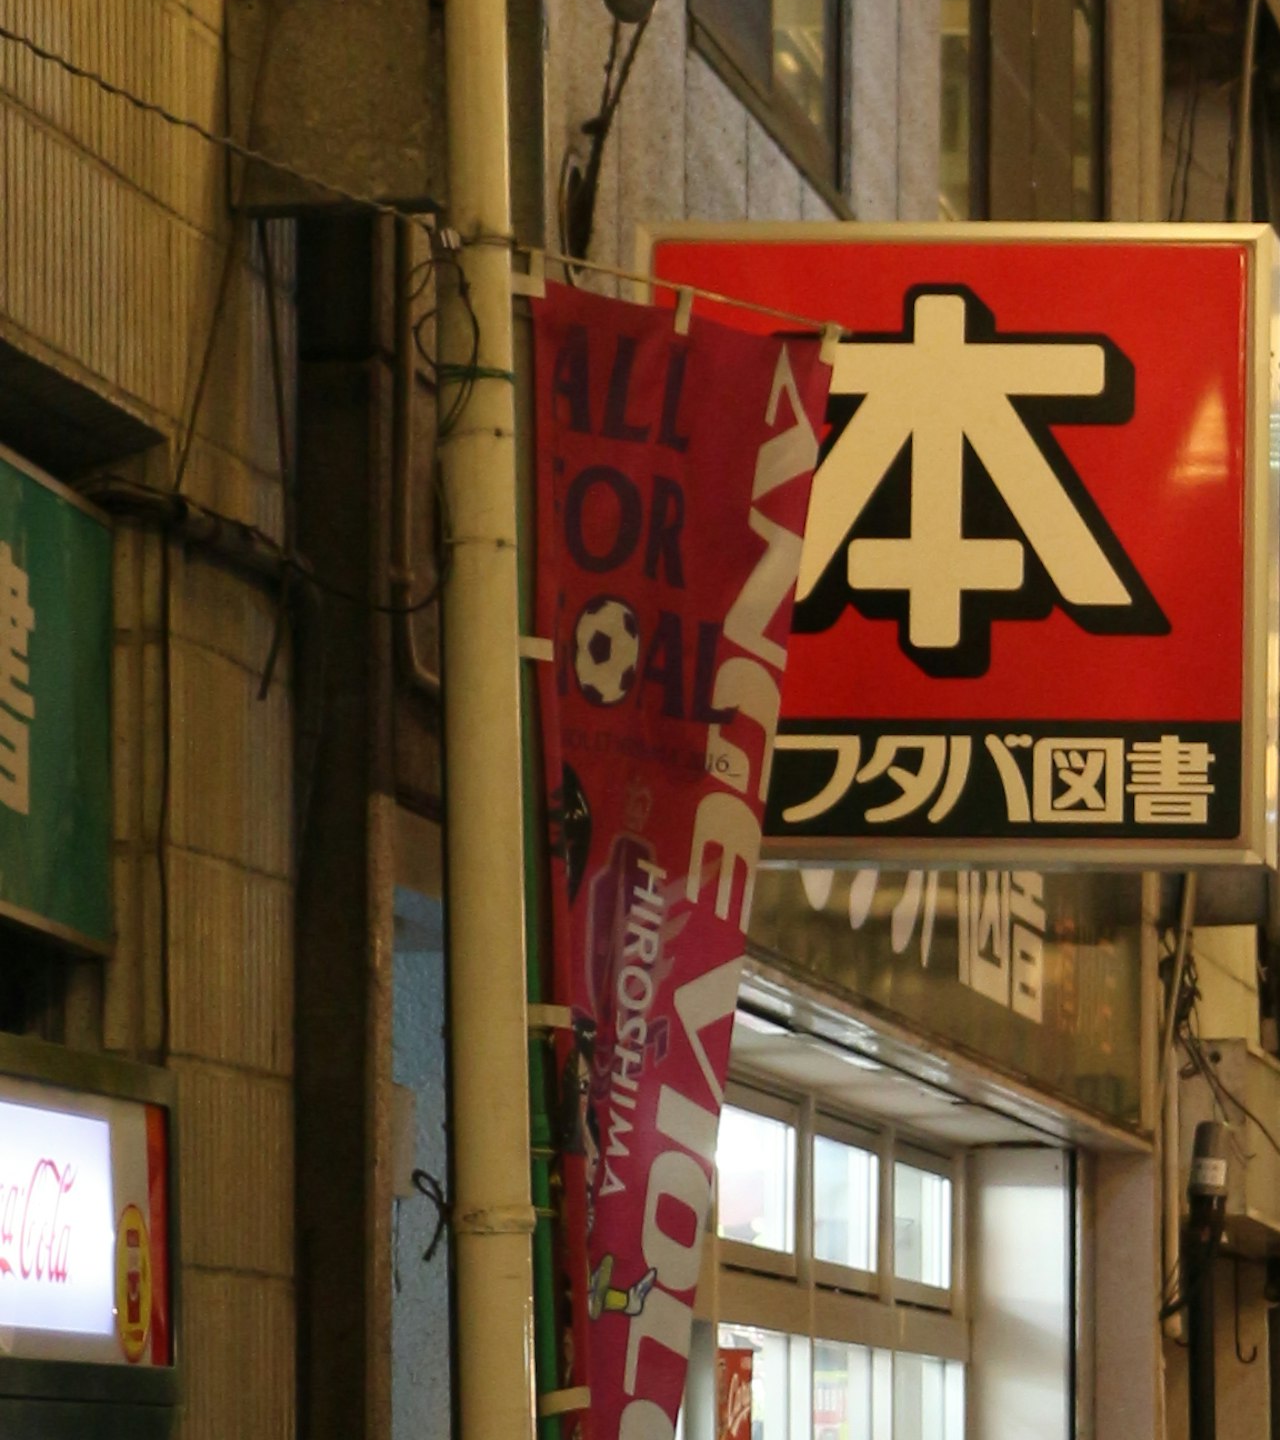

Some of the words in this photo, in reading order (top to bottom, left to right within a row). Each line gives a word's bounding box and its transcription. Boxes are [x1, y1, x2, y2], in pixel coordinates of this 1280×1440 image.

[552, 323, 690, 454] ALL
[792, 290, 1136, 650] 本
[774, 732, 1216, 825] フタバ図書
[599, 858, 668, 1197] HIROSHIMA
